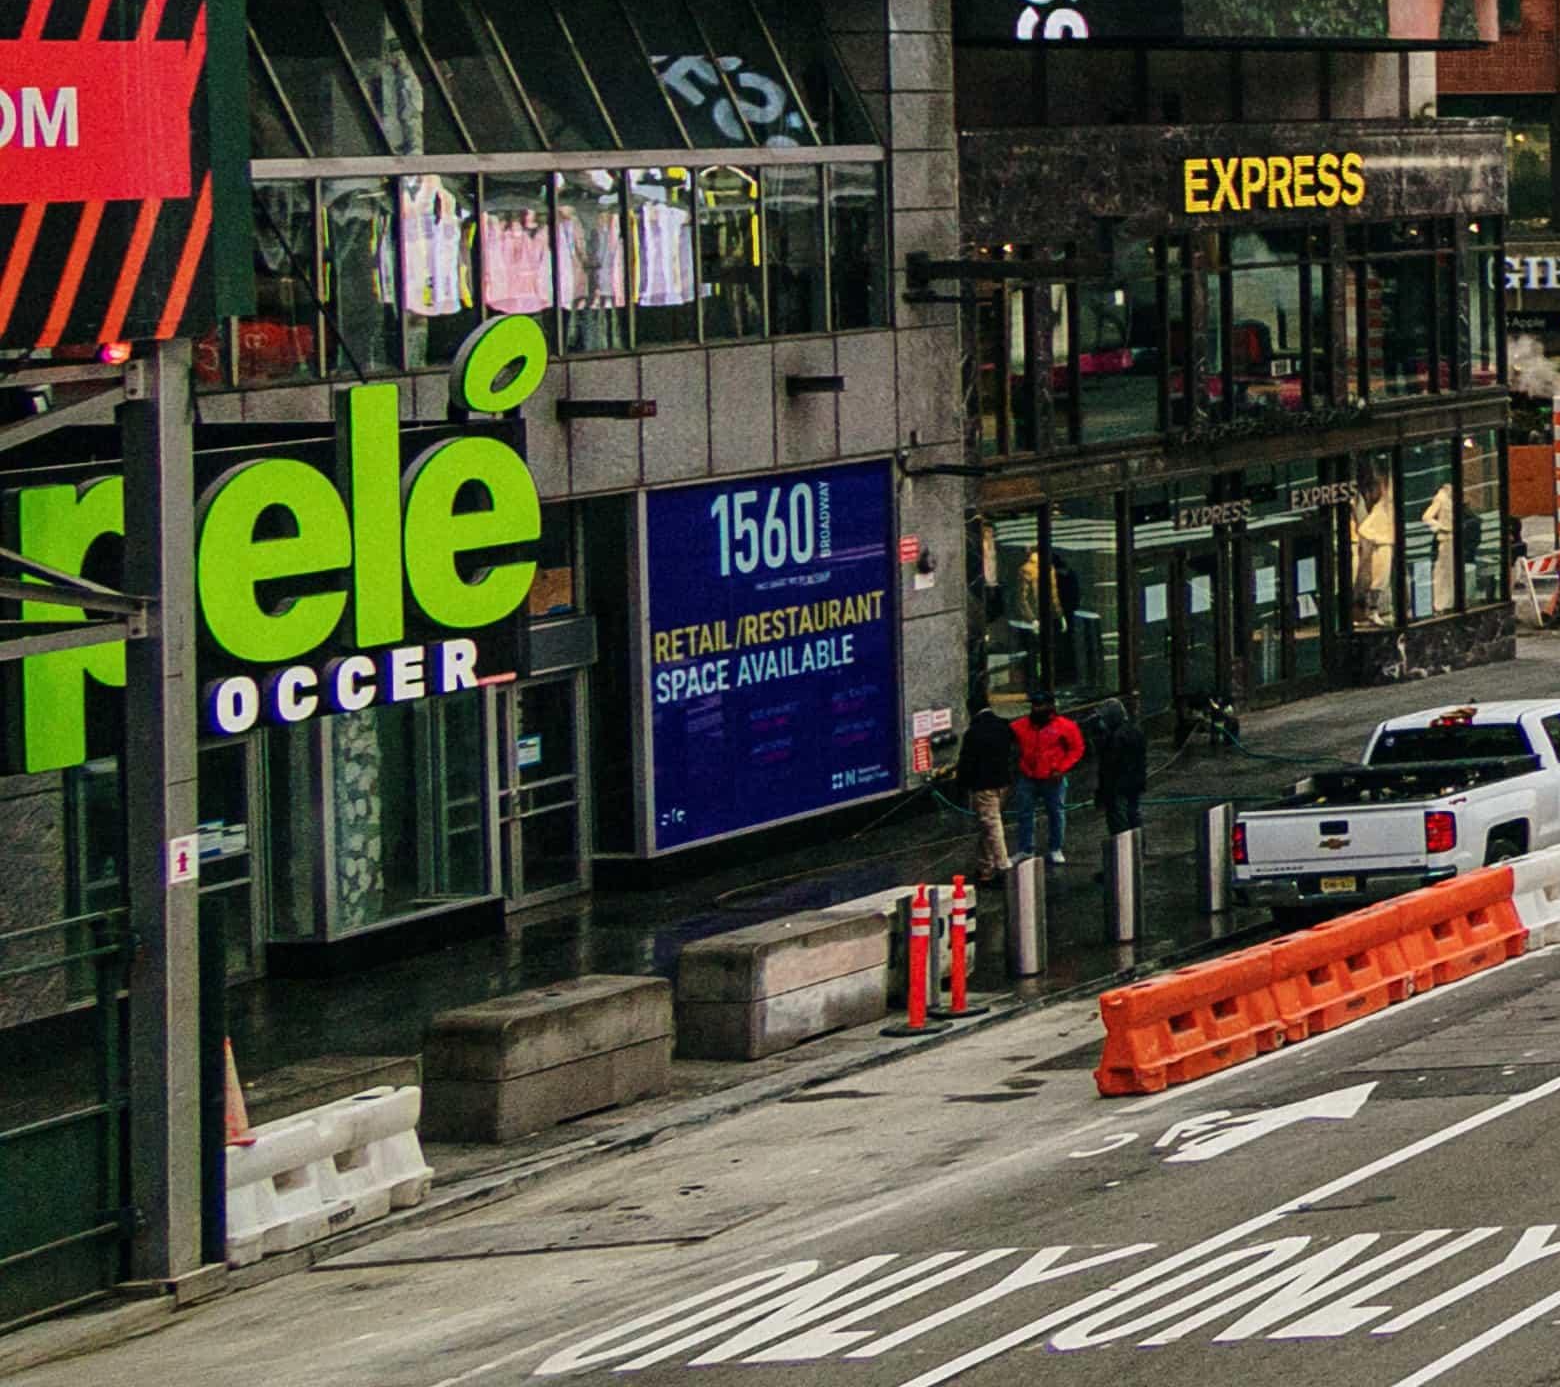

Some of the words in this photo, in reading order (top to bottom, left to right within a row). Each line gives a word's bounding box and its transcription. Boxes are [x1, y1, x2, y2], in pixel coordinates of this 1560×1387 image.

[1183, 151, 1367, 214] EXPRESS
[711, 482, 816, 578] 1560
[820, 481, 832, 559] BROADWAY
[654, 590, 886, 665] RETAIL/RESTAURANT
[656, 657, 731, 705] SPACE
[737, 633, 856, 688] AVAILABLE
[211, 637, 480, 736] OCCER
[534, 1244, 1160, 1380] ONLY
